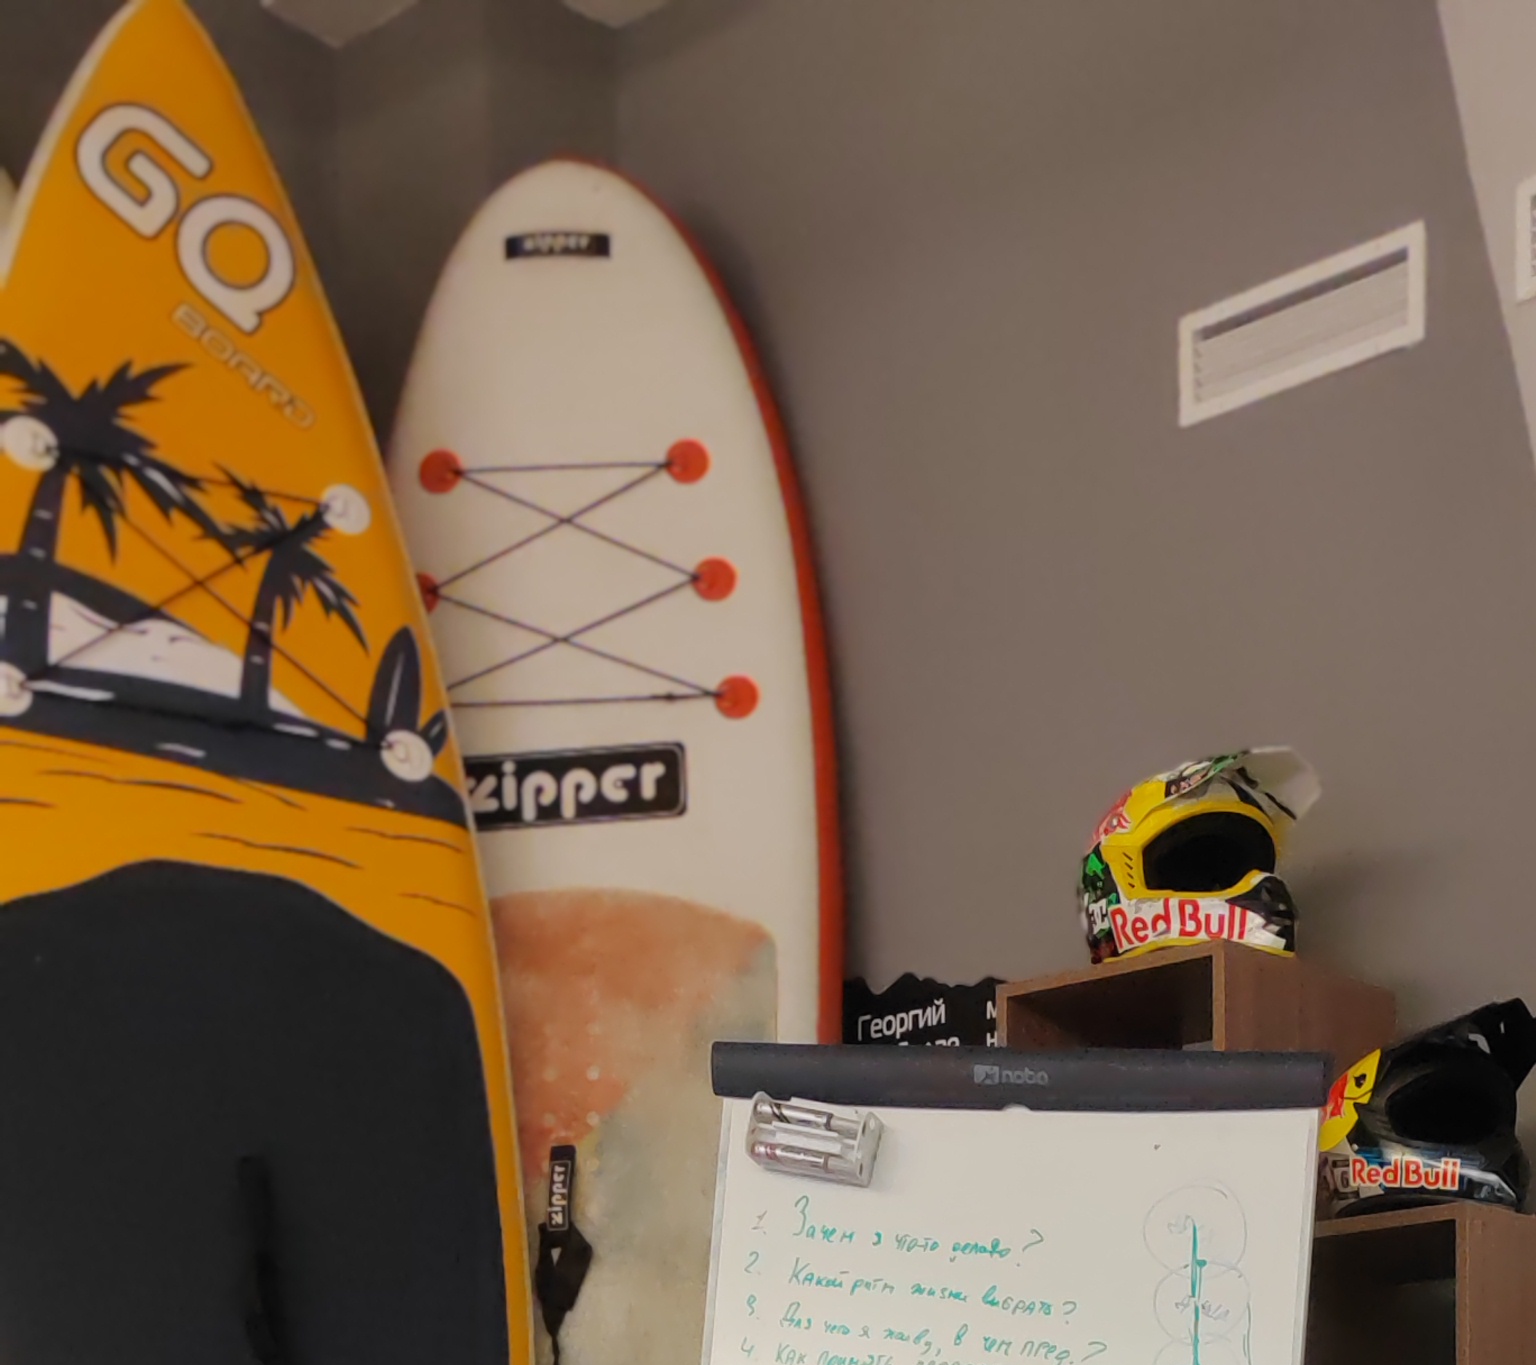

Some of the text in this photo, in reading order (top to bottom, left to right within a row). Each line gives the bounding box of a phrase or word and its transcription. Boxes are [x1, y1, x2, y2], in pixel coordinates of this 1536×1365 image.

[171, 302, 316, 430] BOARD
[1109, 897, 1249, 950] Red Bull
[857, 997, 947, 1042] Георгий
[547, 1165, 568, 1226] zipper
[1351, 1157, 1399, 1186] Red
[1404, 1159, 1459, 1189] Bull
